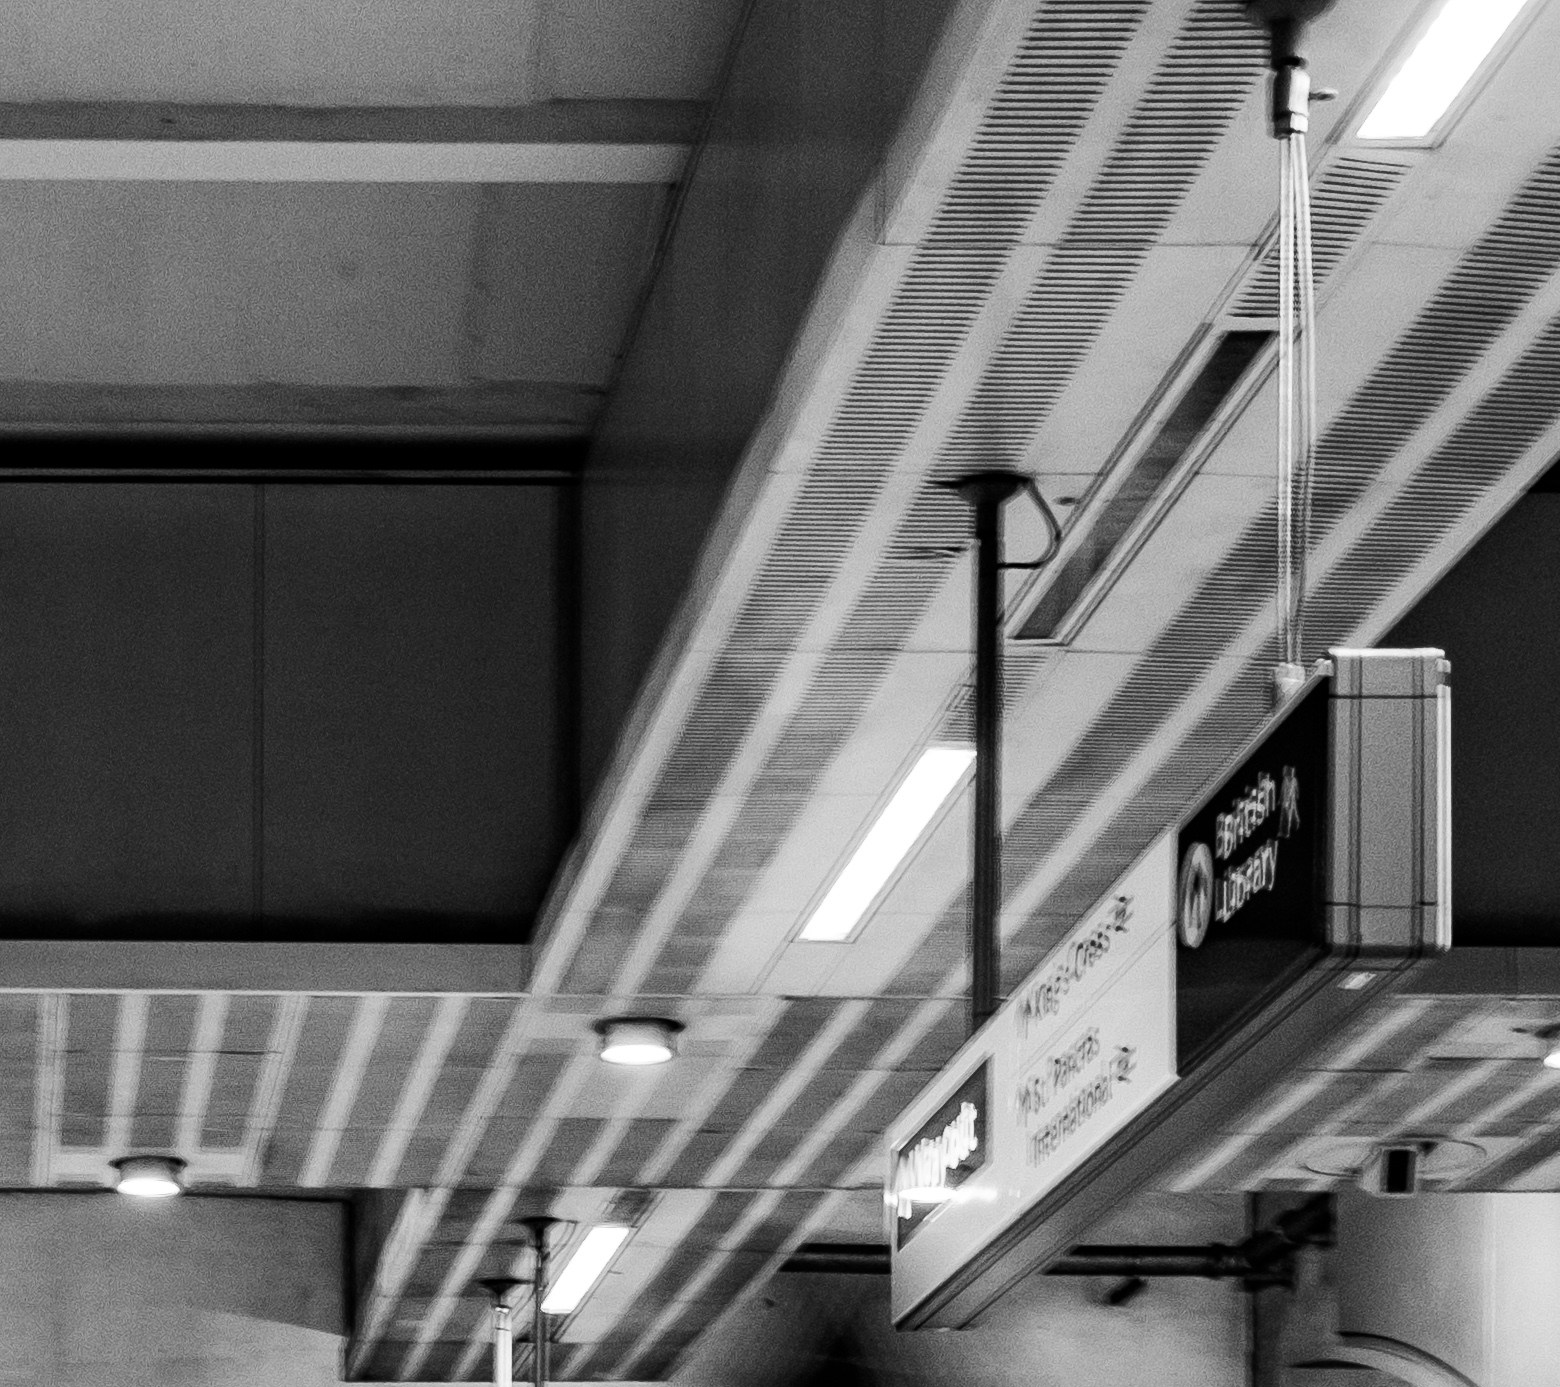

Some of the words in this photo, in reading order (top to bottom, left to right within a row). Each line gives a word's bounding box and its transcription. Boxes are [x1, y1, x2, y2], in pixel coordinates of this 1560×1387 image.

[1215, 771, 1276, 860] British
[1215, 839, 1278, 923] Library
[1068, 924, 1111, 982] Cross
[1047, 1027, 1099, 1092] Pancras
[1027, 1060, 1112, 1168] International
